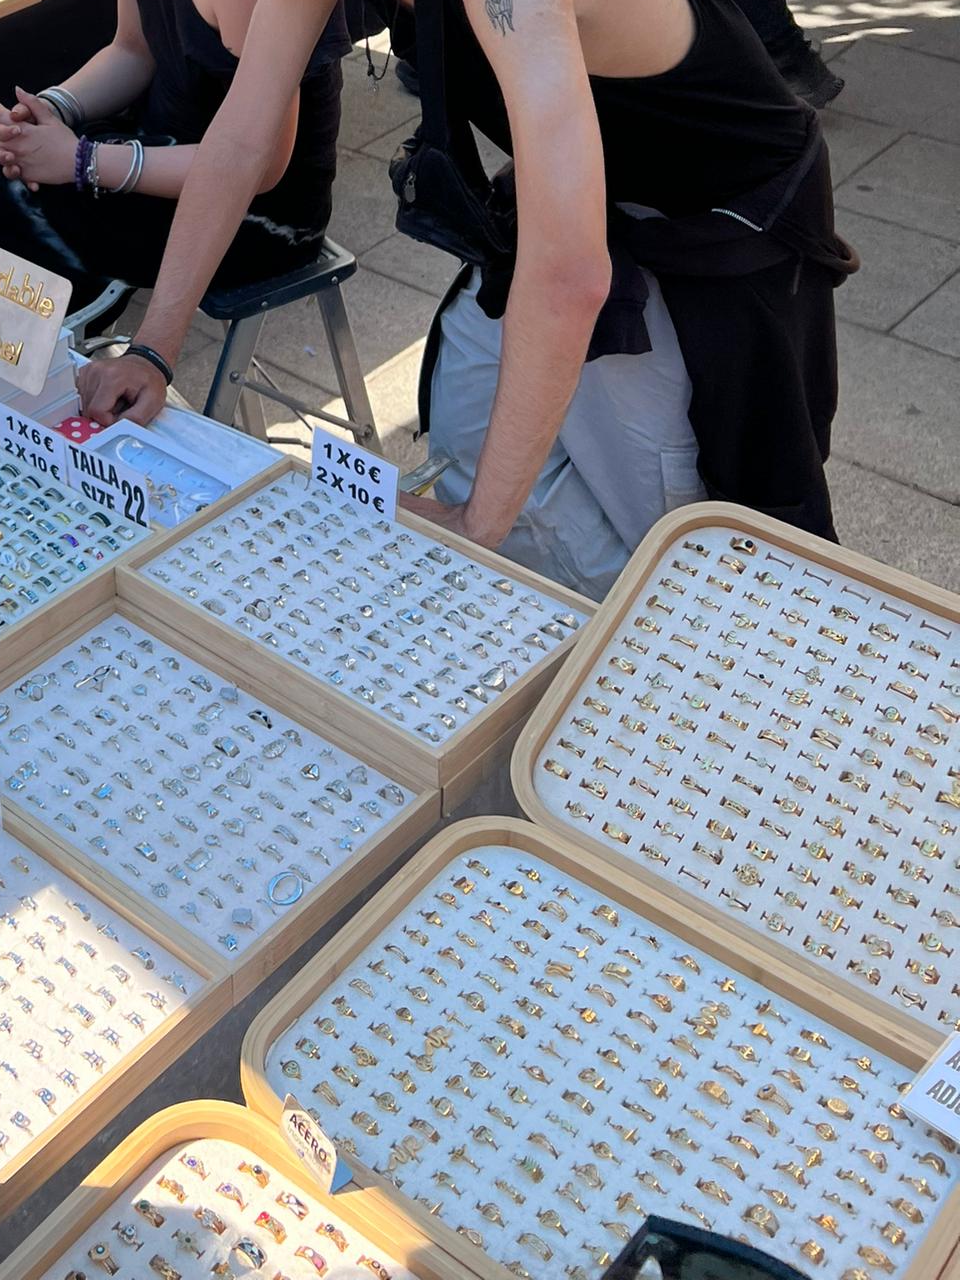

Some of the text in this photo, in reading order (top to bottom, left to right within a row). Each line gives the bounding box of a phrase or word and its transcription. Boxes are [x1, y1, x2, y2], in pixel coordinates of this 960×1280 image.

[6, 415, 54, 453] 1X6€
[68, 444, 120, 490] TALLA
[323, 442, 381, 484] 1X6€
[122, 480, 147, 528] 22
[316, 466, 385, 514] 2X10€
[289, 1113, 328, 1162] ACERO
